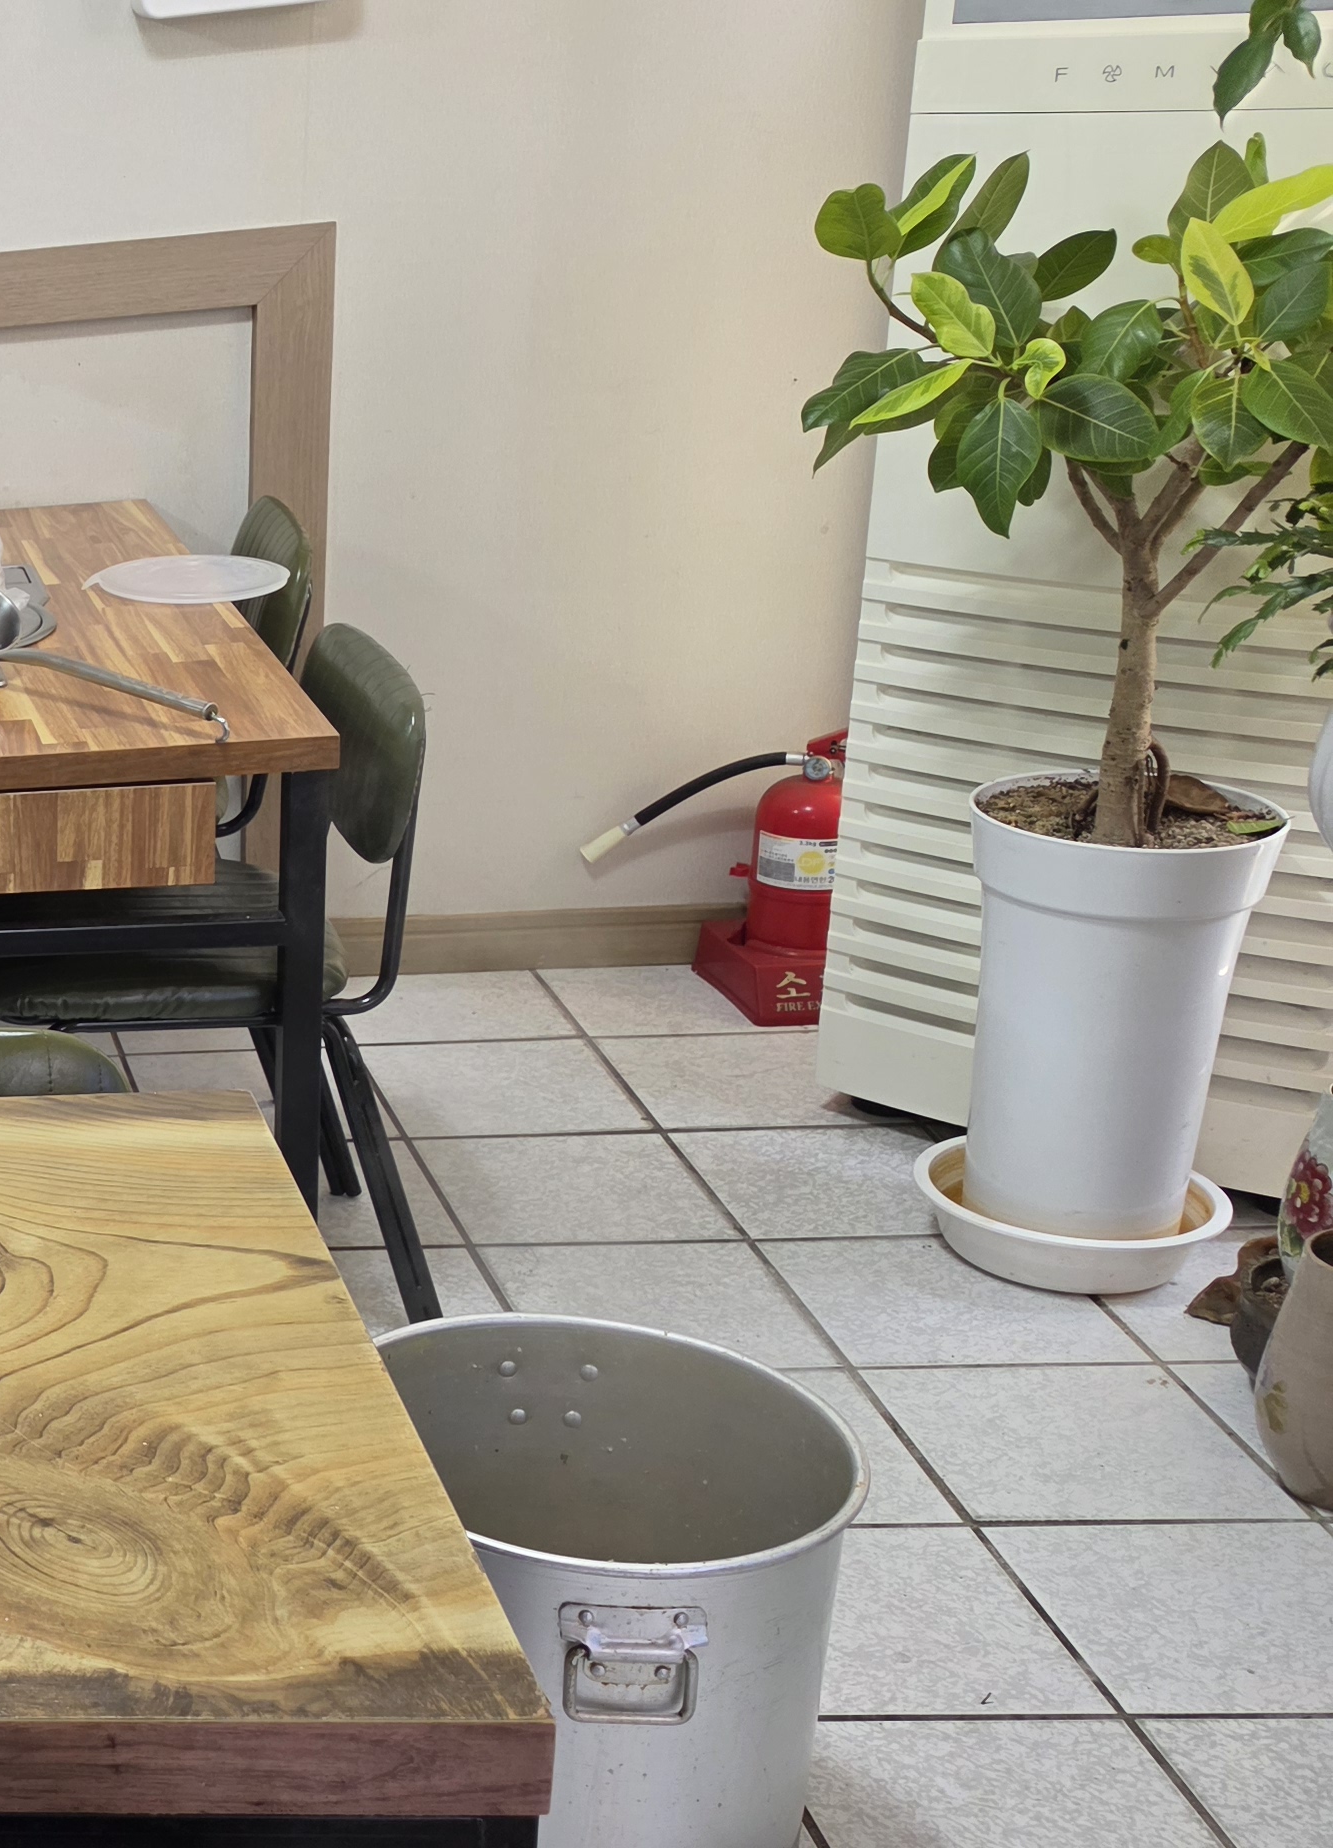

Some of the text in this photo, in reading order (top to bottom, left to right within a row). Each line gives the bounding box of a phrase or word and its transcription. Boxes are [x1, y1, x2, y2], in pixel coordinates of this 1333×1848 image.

[1055, 65, 1175, 82] F M
[776, 1001, 805, 1012] FIRE
